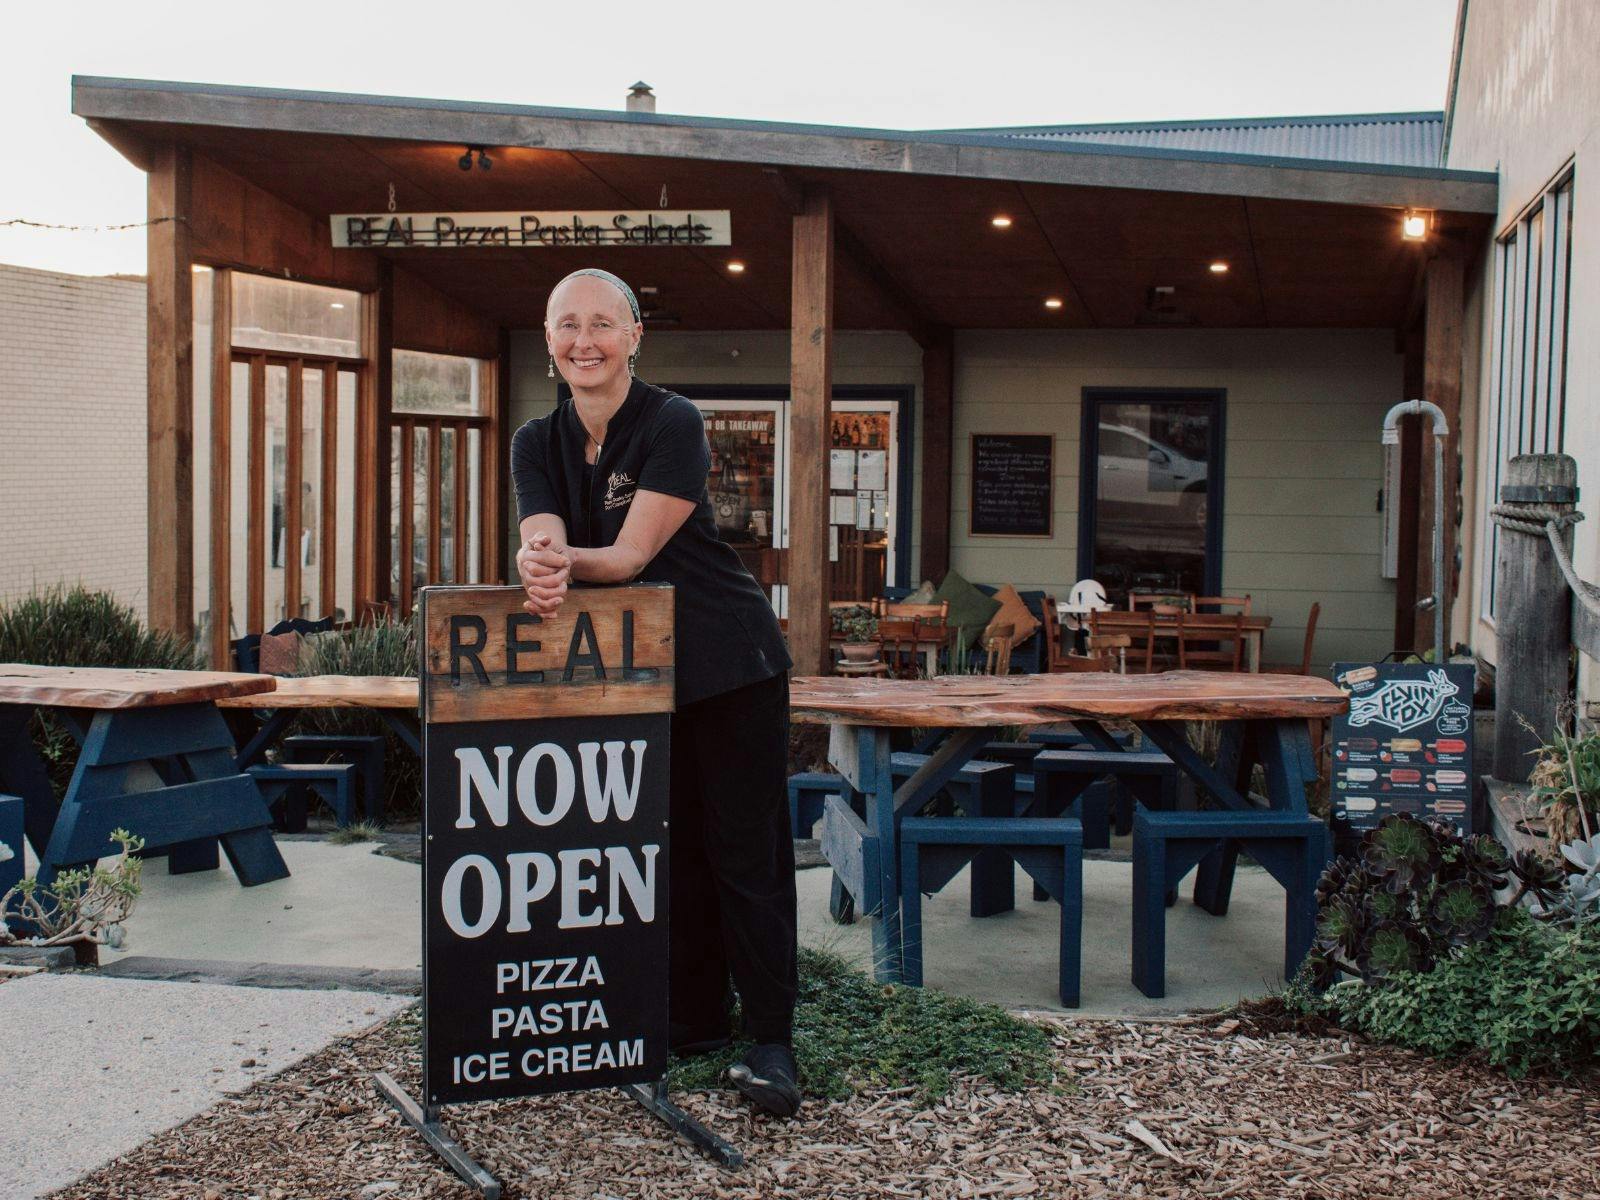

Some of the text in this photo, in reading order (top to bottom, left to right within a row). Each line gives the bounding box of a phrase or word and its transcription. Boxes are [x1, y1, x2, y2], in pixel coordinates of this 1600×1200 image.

[347, 214, 708, 247] REAL Pizza Pasta Salads
[715, 420, 725, 430] OR
[729, 420, 768, 431] TAKEAWAY
[450, 610, 660, 687] REAL
[1390, 698, 1430, 724] FOX
[455, 740, 648, 829] NOW
[441, 844, 660, 939] OPEN
[497, 955, 605, 994] PIZZA
[492, 1000, 609, 1039] PASTA
[453, 1039, 645, 1085] ICE CREAM
